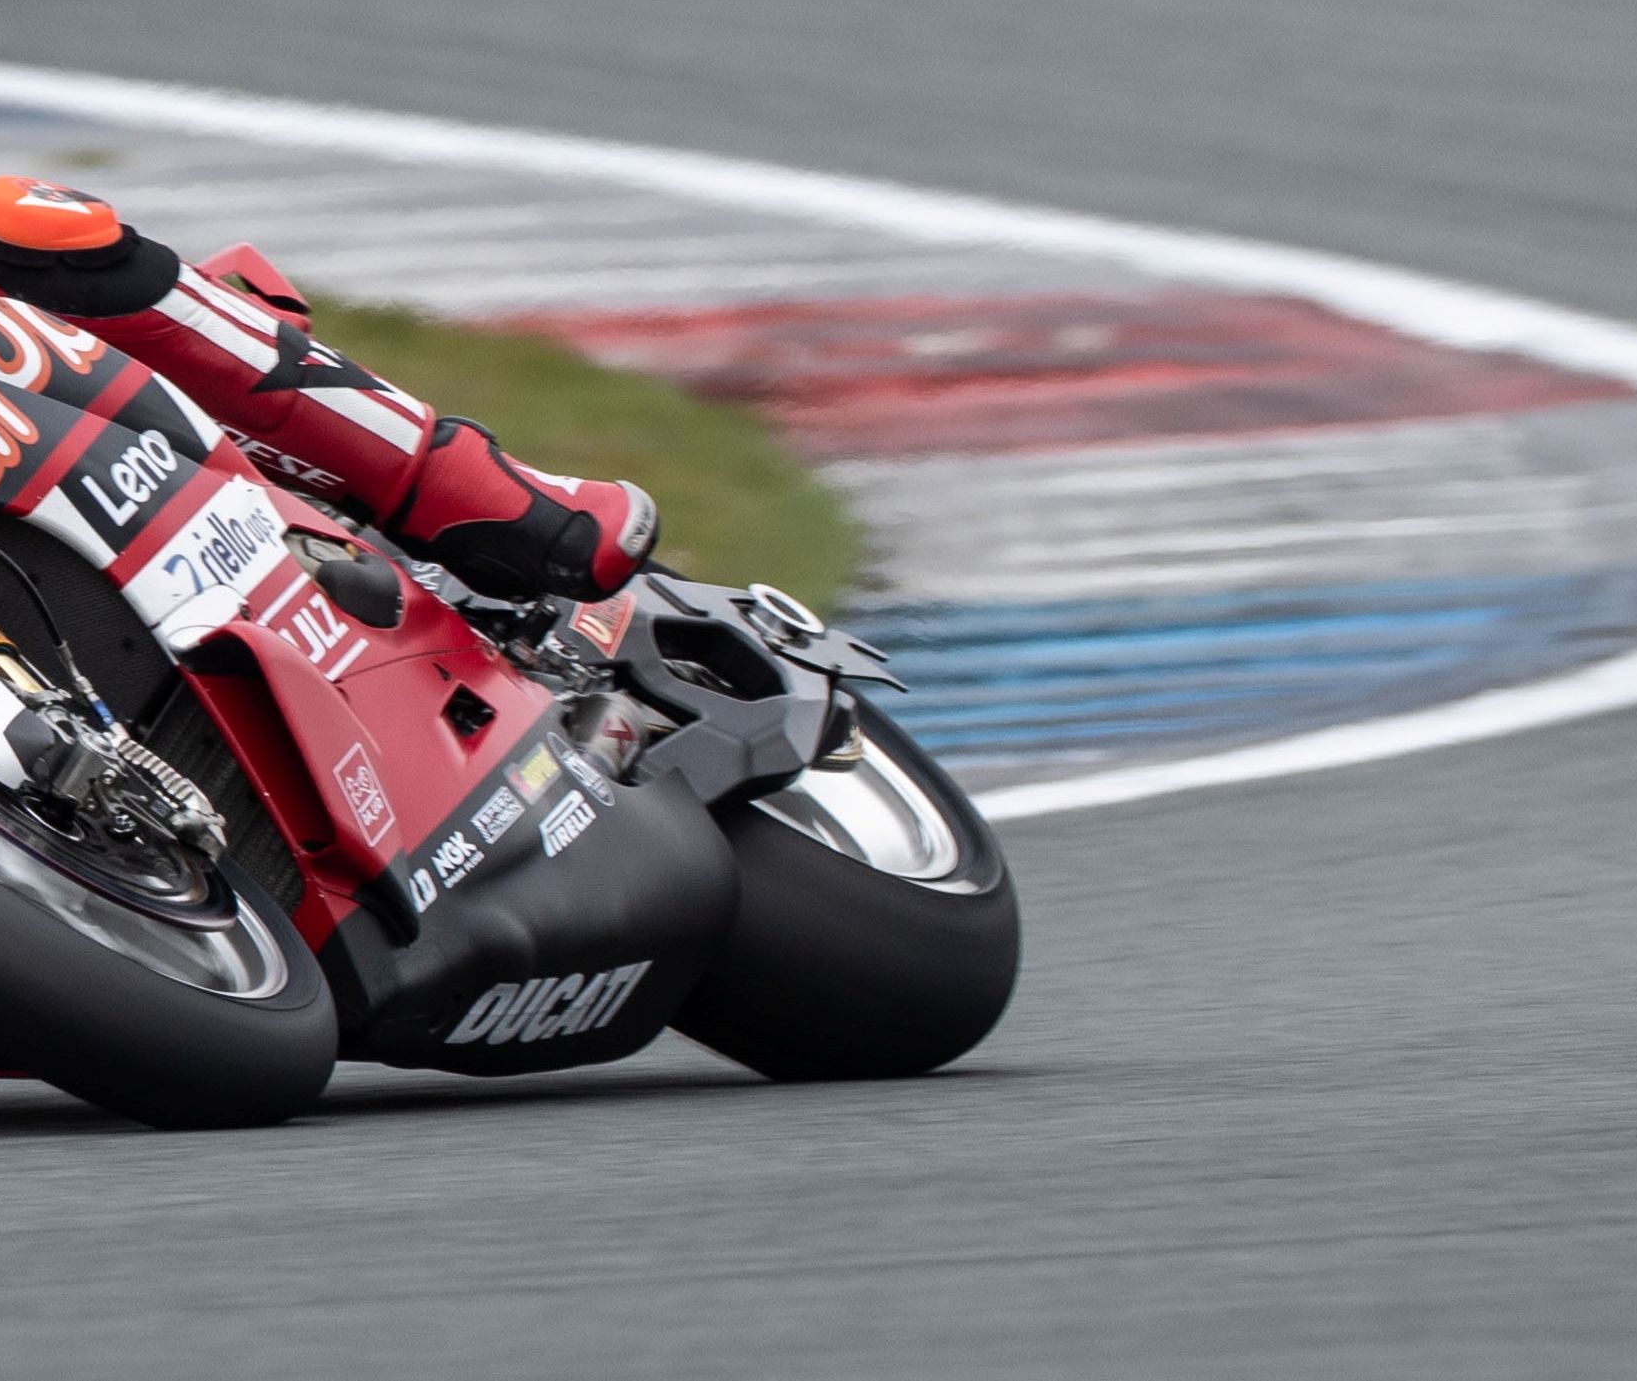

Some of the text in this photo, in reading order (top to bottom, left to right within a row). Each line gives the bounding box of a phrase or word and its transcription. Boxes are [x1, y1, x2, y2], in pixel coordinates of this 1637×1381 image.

[431, 830, 478, 878] NGK
[539, 789, 597, 858] PIRELLI
[444, 959, 654, 1045] DUCATI
